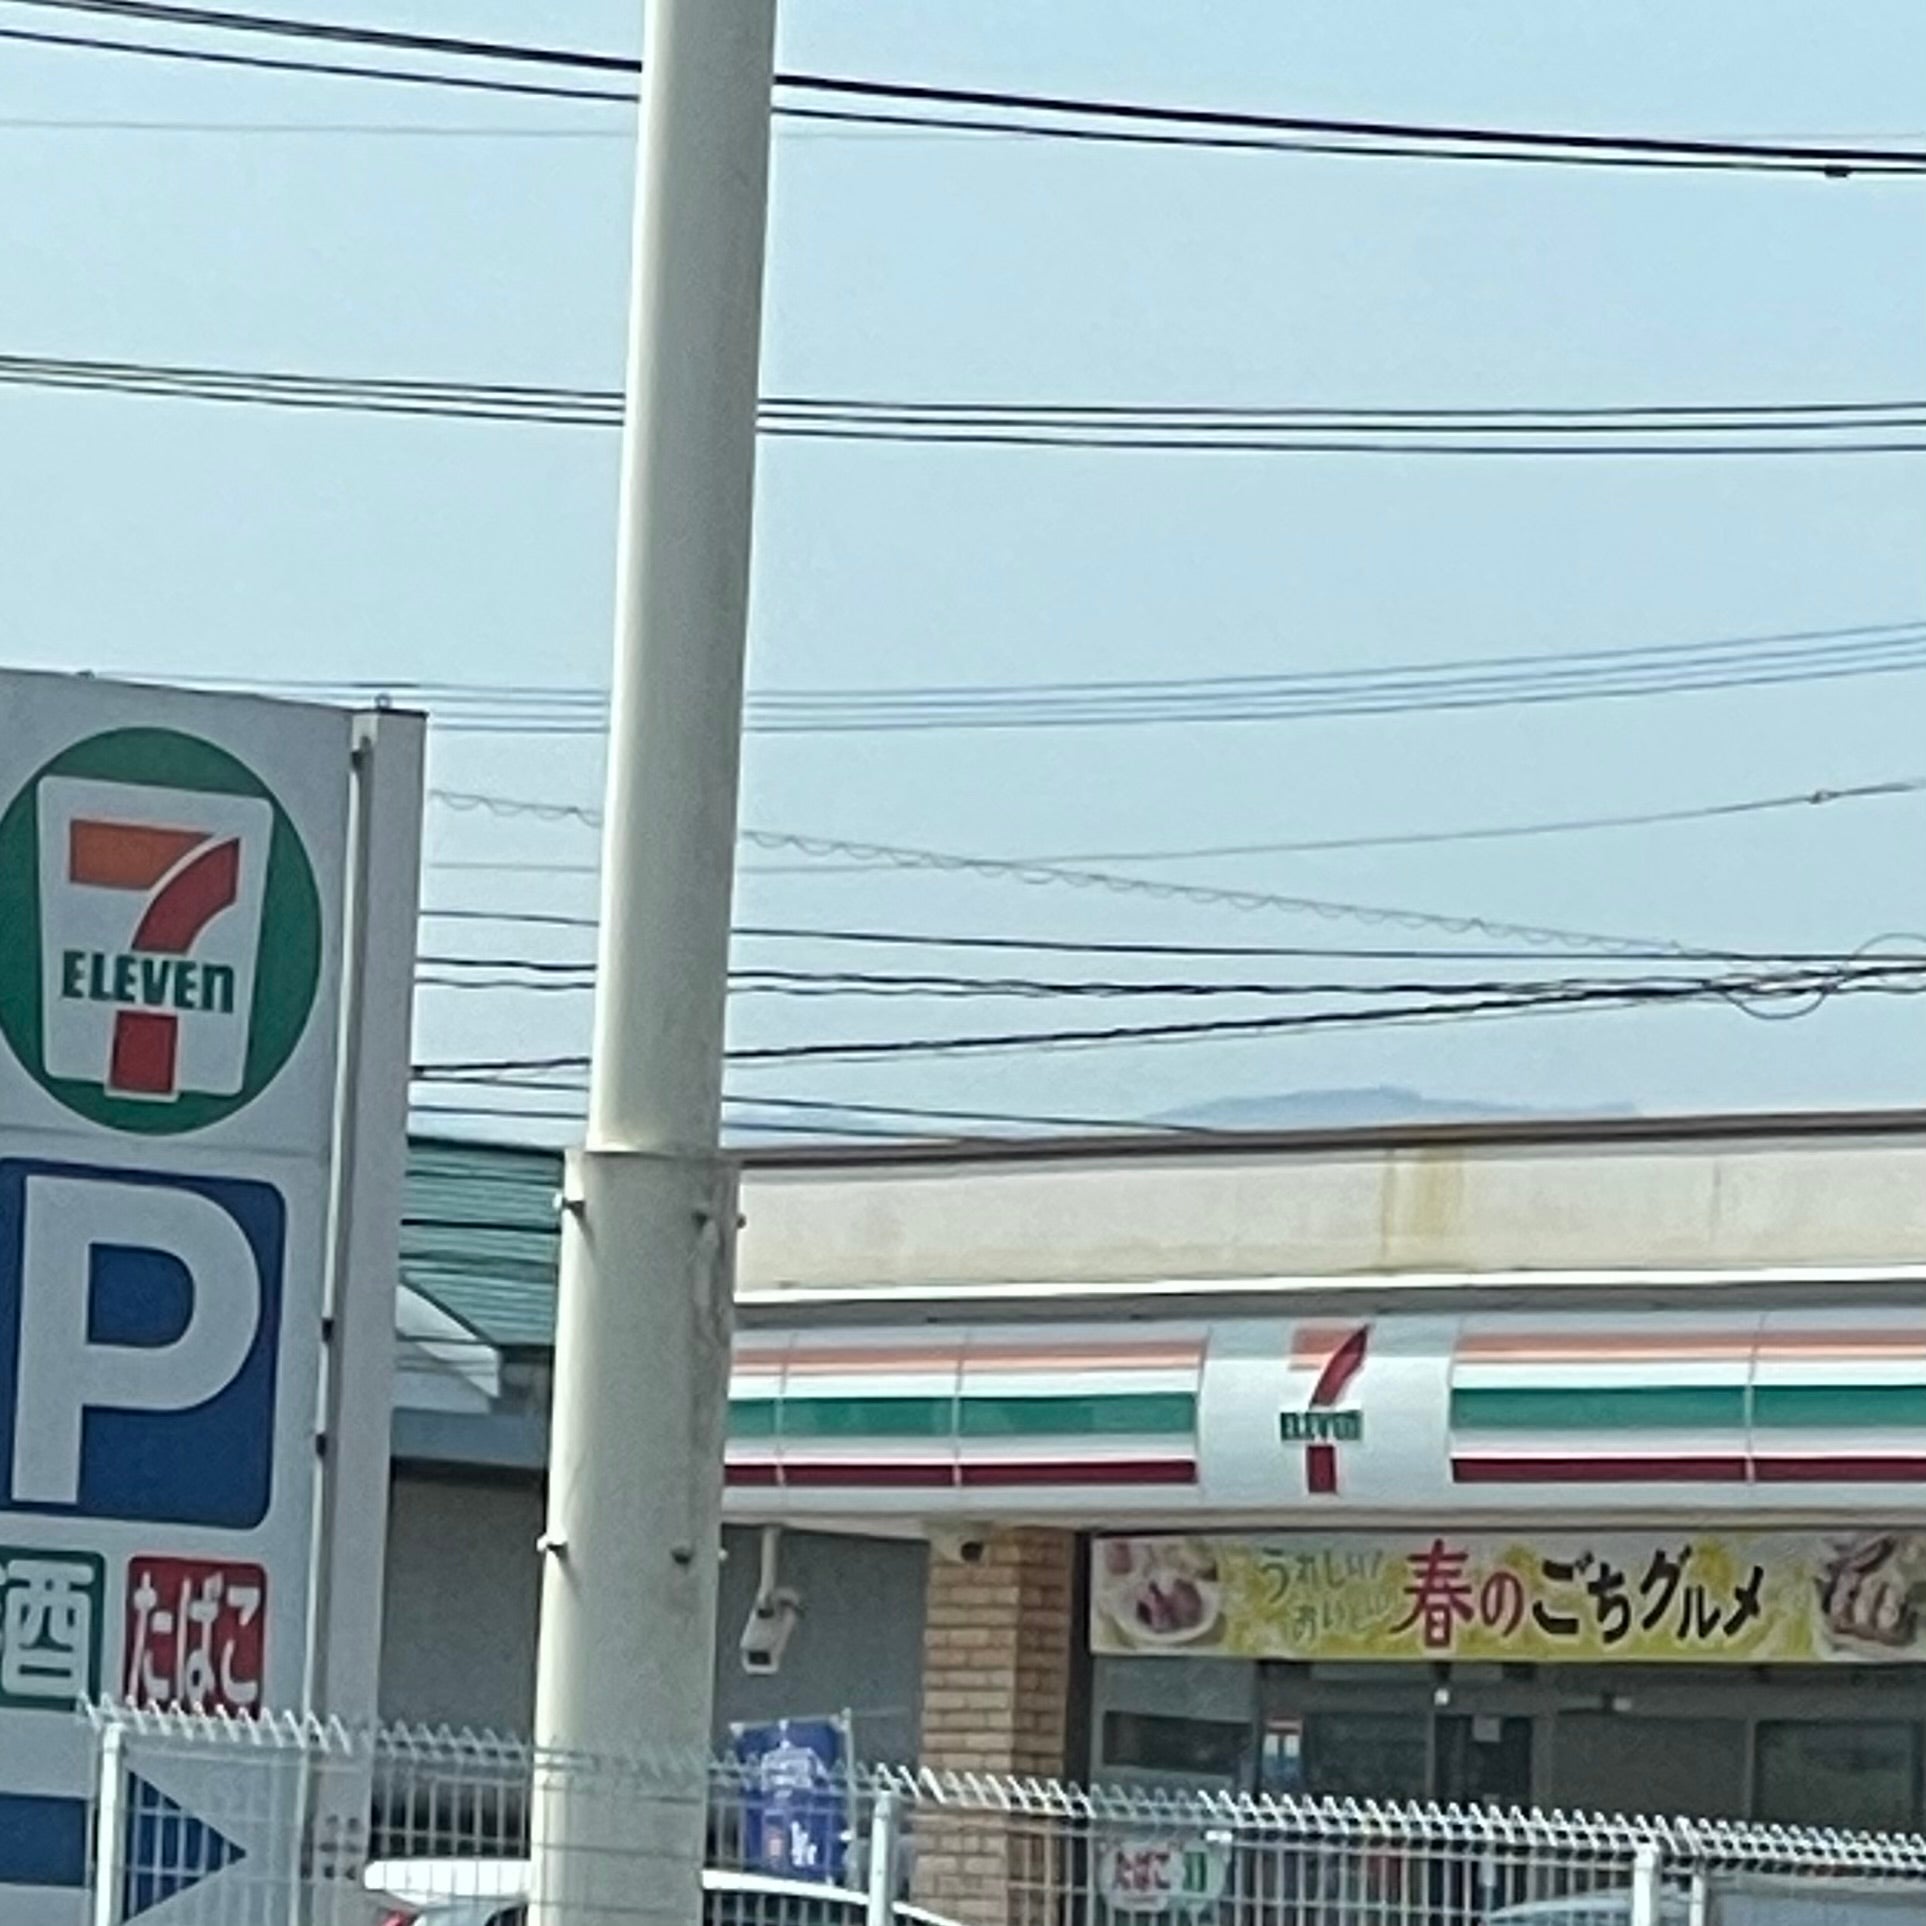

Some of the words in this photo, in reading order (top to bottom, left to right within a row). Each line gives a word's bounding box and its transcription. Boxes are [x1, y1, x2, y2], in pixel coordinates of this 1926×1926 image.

[69, 817, 241, 1096] 7
[11, 1174, 263, 1504] P
[1288, 1322, 1372, 1495] 7
[128, 1570, 264, 1706] たばこ
[1388, 1538, 1764, 1649] 春のごちグルメ
